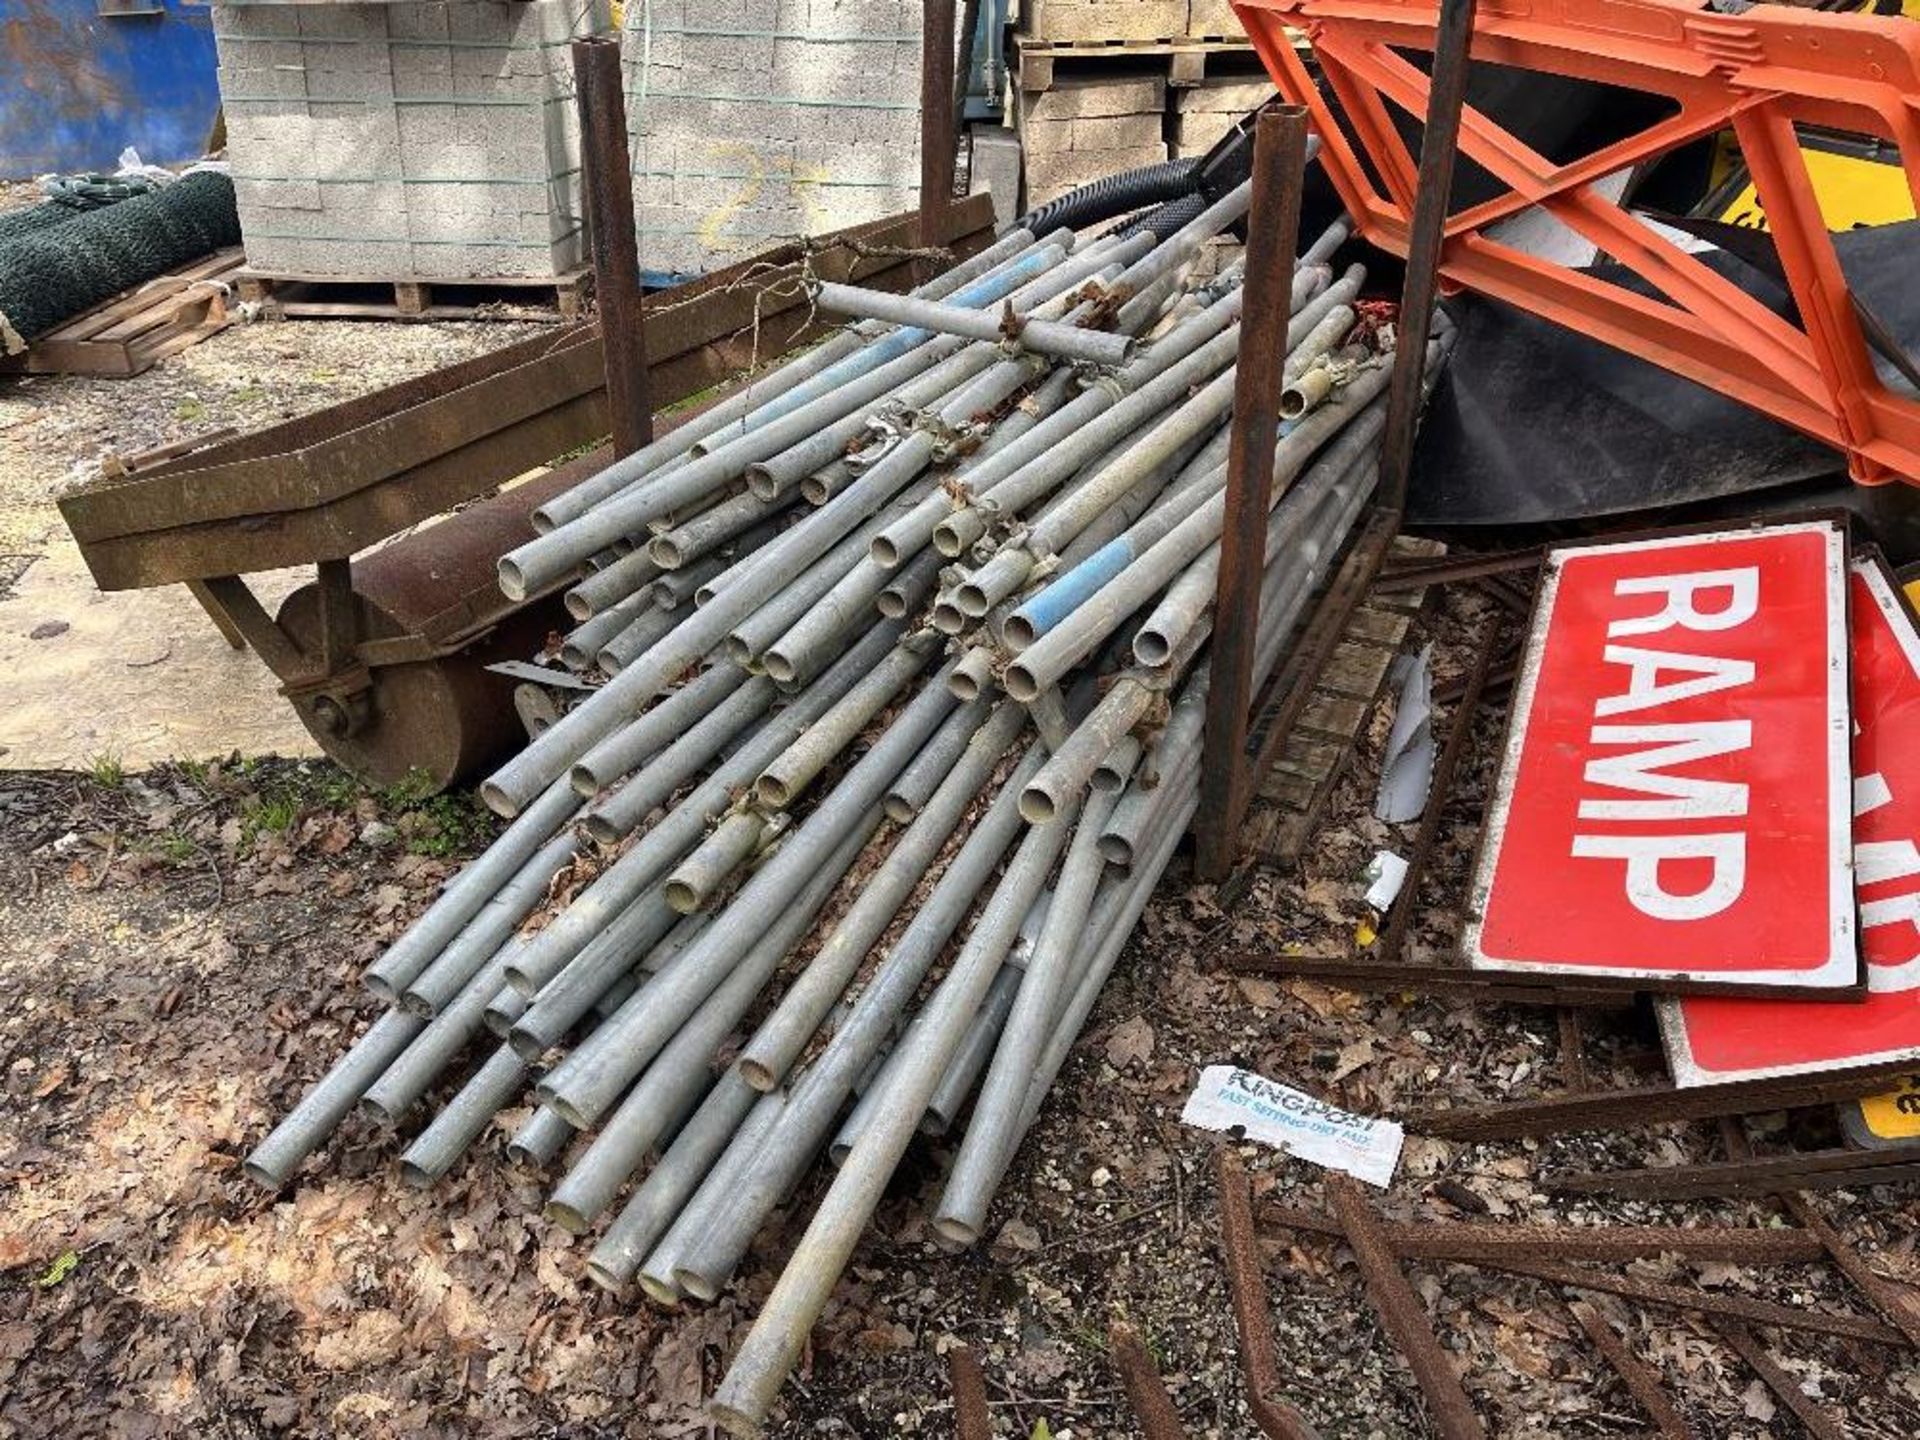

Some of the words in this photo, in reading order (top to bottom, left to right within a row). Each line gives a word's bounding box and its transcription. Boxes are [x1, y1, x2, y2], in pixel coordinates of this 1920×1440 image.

[1570, 566, 1759, 921] RAMP
[1217, 1088, 1252, 1106] FAST
[1251, 1102, 1307, 1128] SETTING
